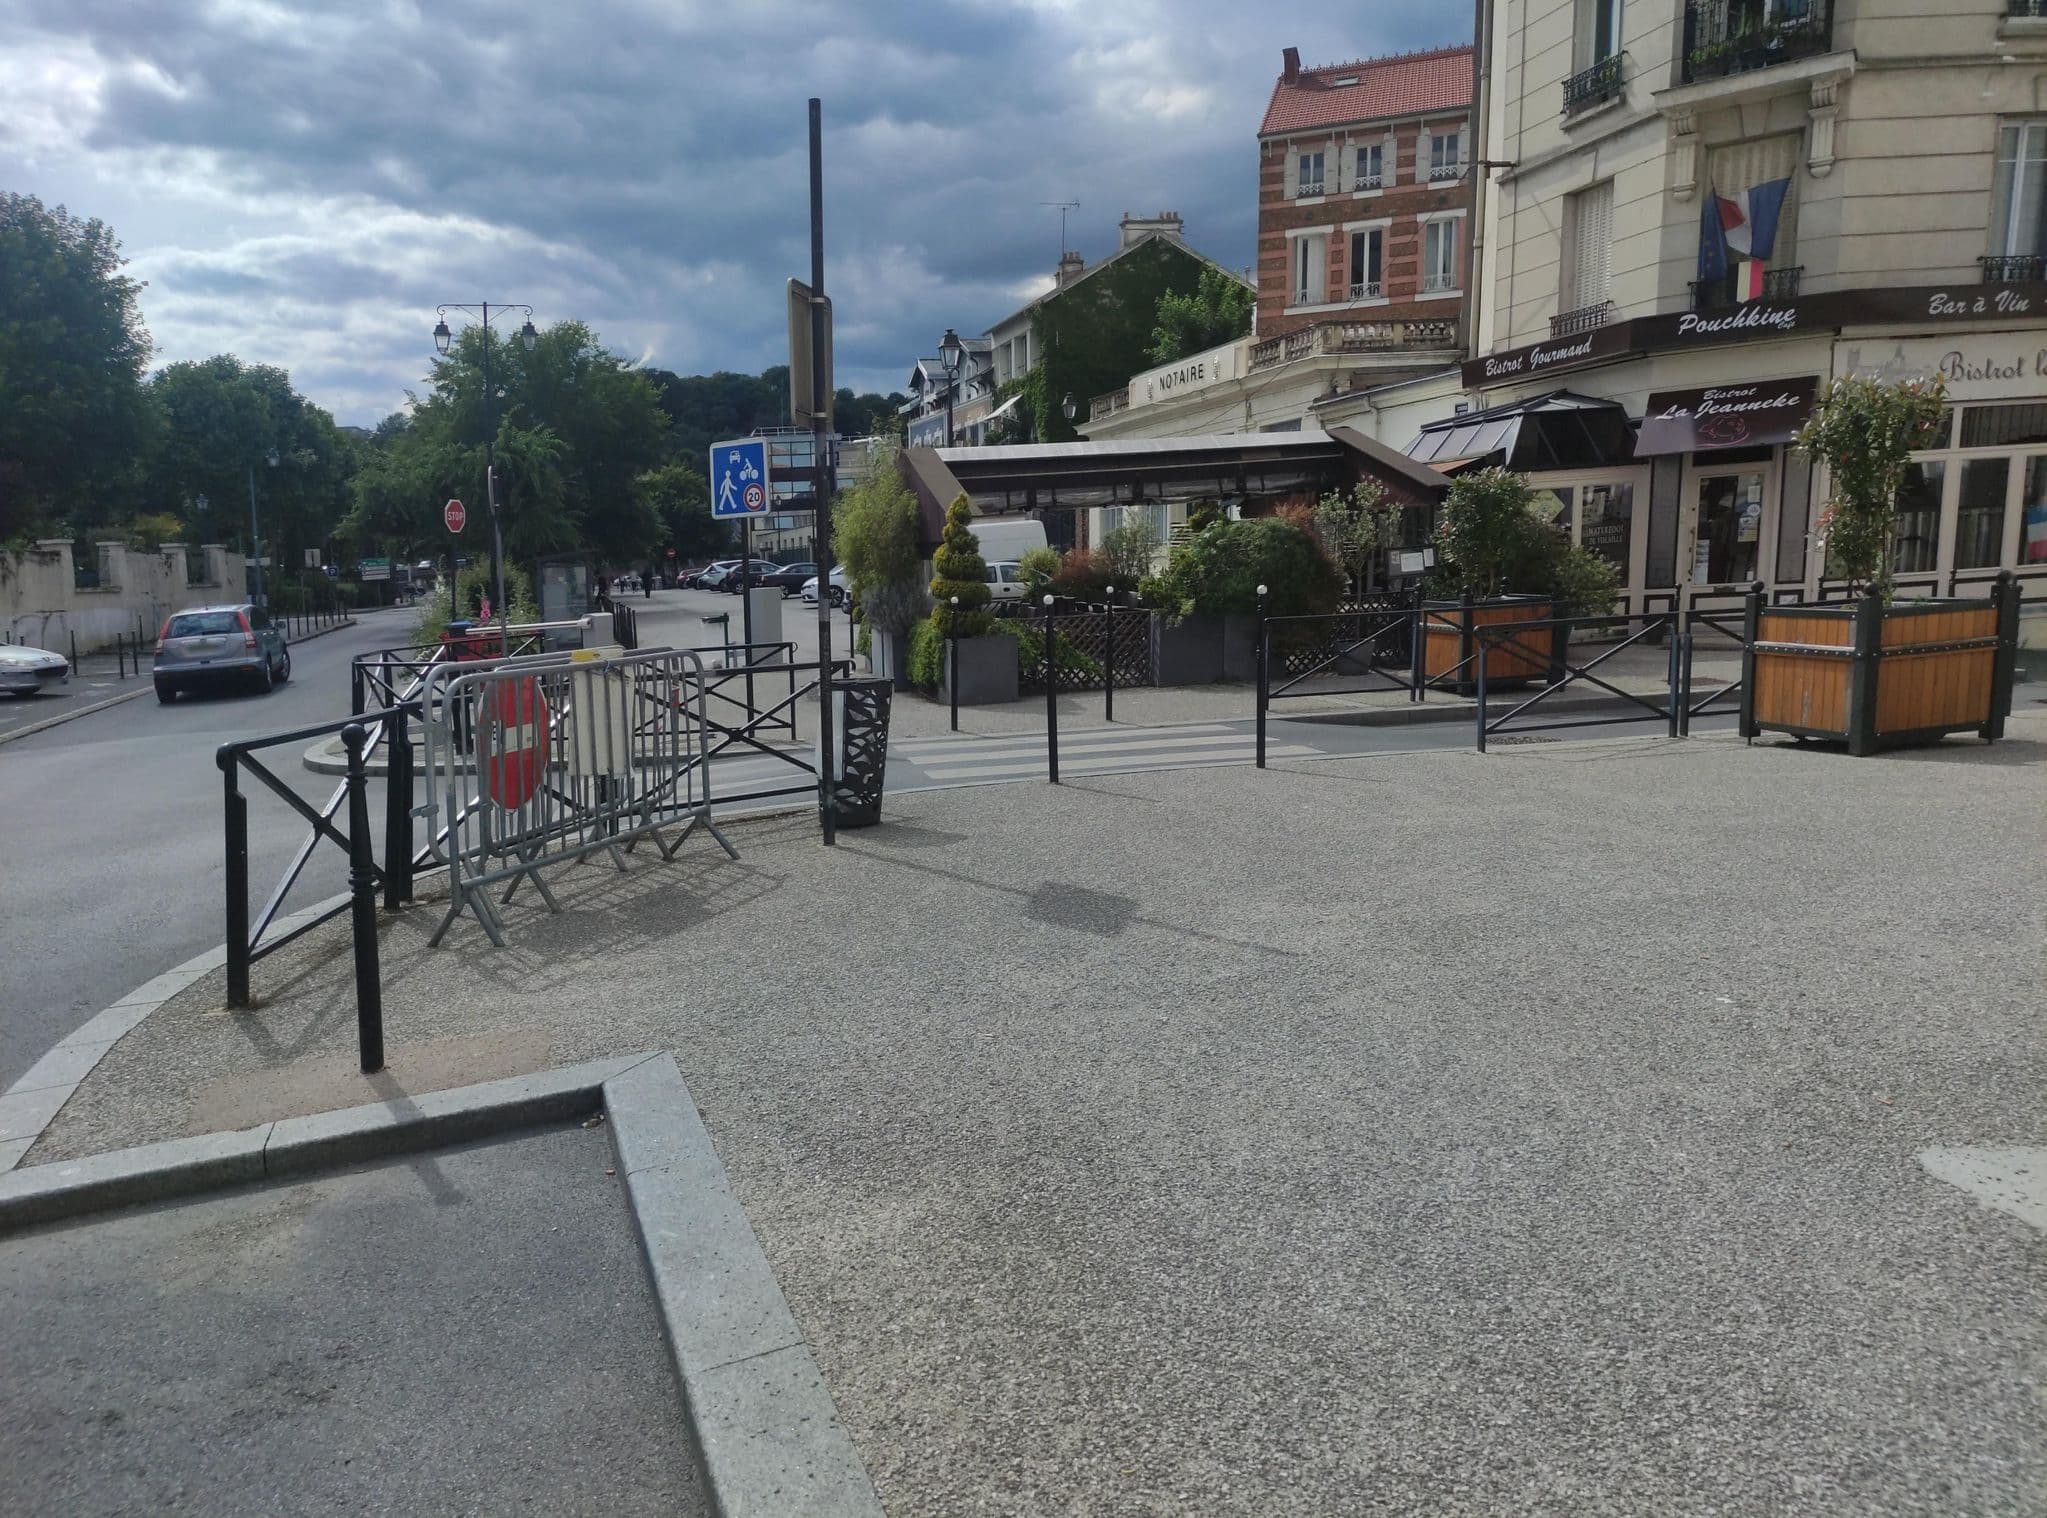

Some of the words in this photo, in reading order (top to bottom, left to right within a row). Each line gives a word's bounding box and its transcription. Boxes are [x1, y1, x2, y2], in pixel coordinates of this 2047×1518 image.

[1928, 293, 1967, 315] Bar
[1973, 297, 1986, 313] à
[1995, 290, 2029, 312] Vin
[1678, 306, 1797, 335] Pouchkine
[1485, 356, 1523, 377] Bistrot
[1530, 334, 1593, 370] Gourmand
[1940, 351, 2024, 381] Bistrot
[1159, 363, 1204, 391] NOTAIRE
[1654, 404, 1690, 420] La
[1694, 392, 1801, 420] Jeanneke
[1703, 387, 1758, 401] Bistrot
[748, 492, 760, 503] 20
[447, 511, 464, 521] STOP
